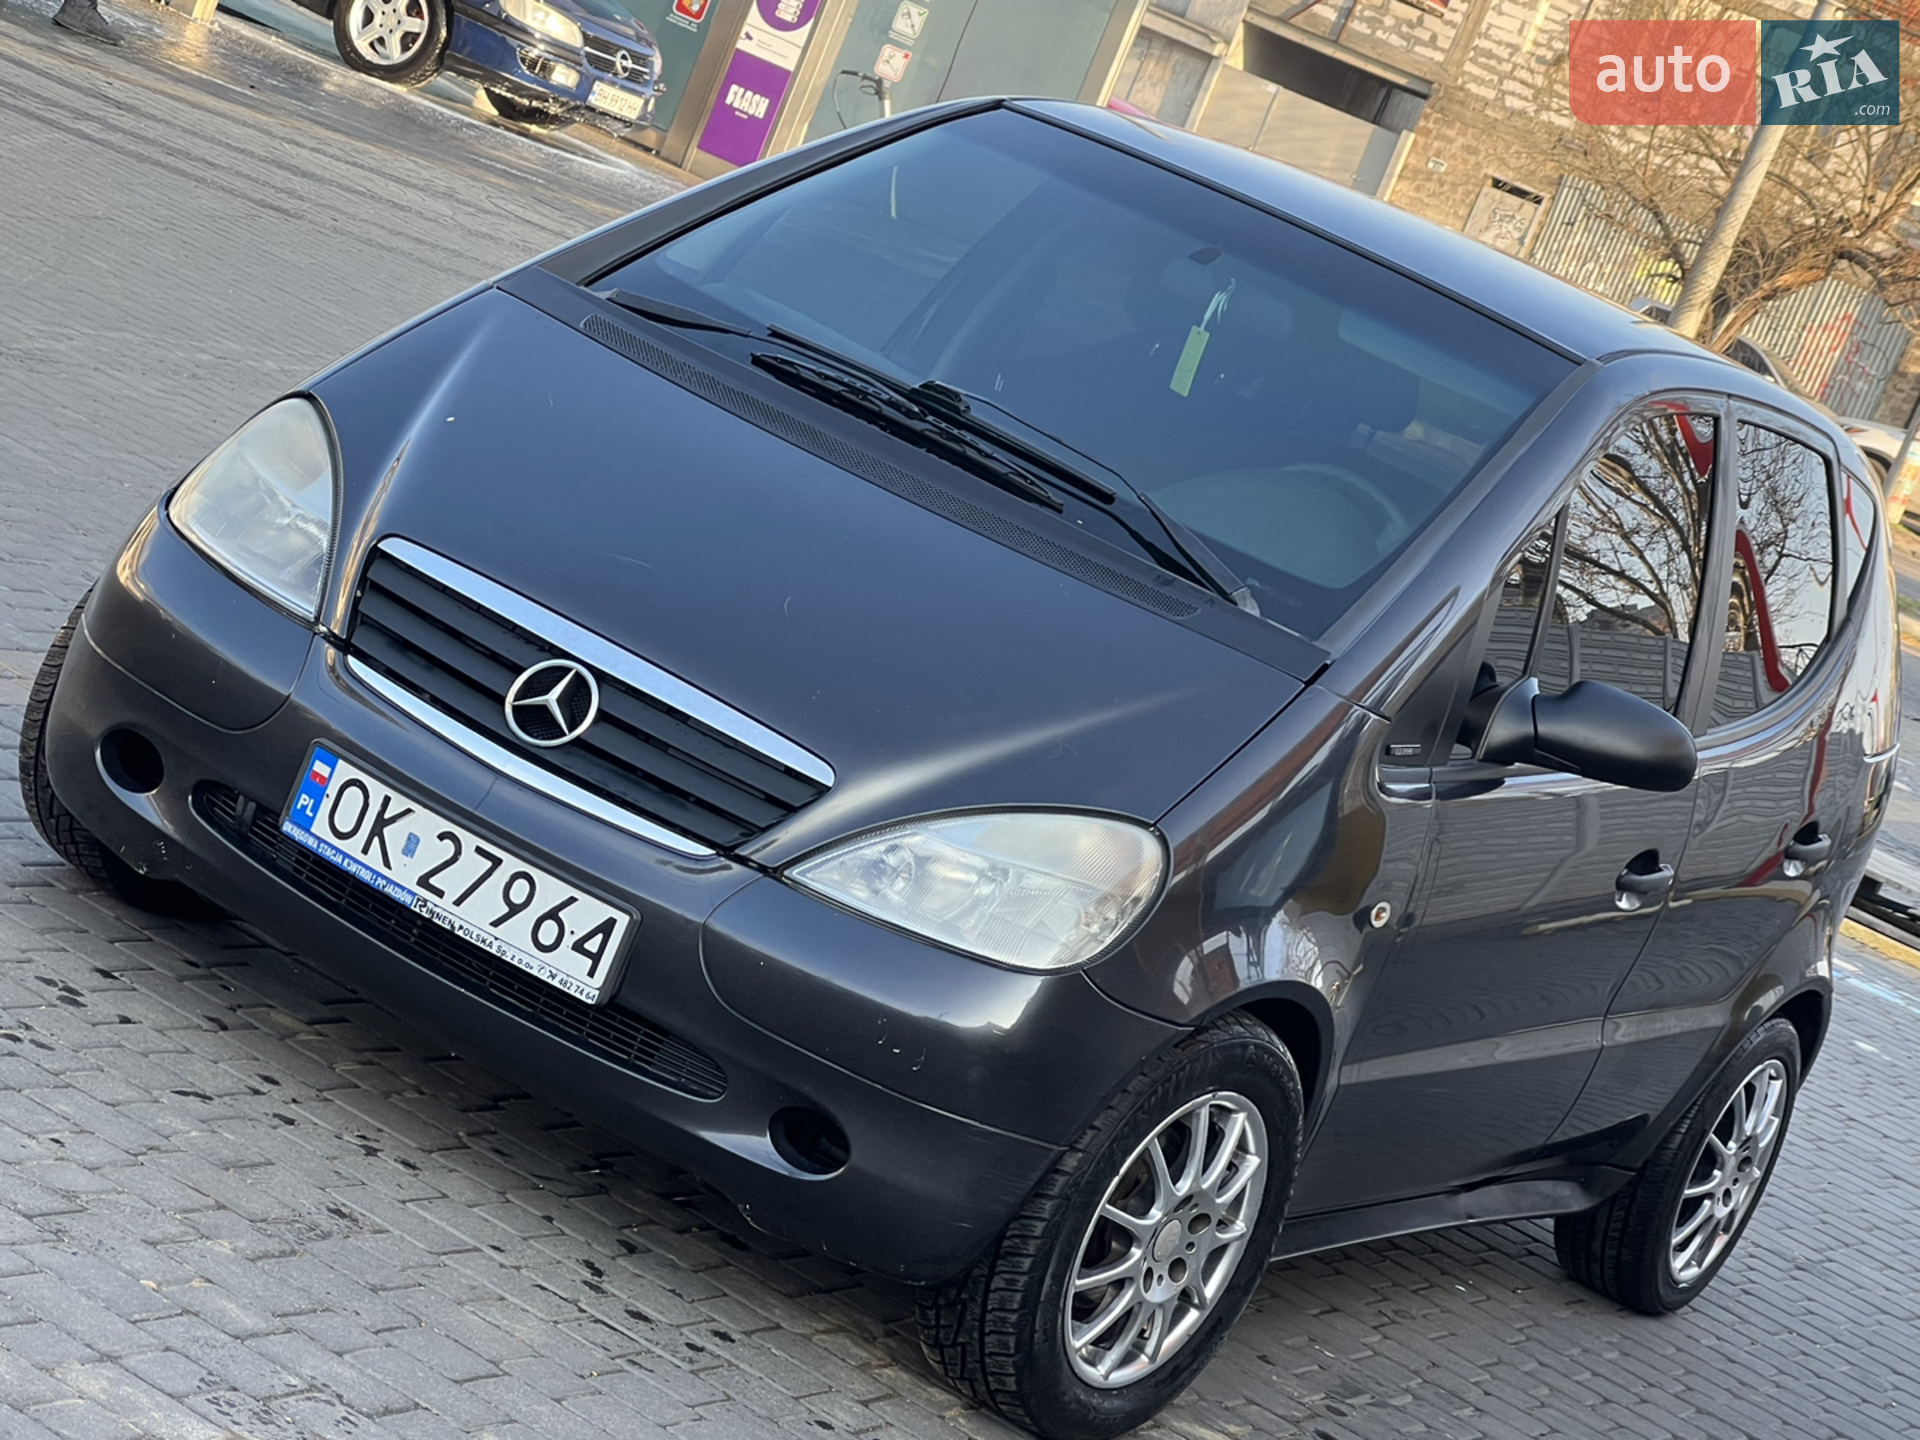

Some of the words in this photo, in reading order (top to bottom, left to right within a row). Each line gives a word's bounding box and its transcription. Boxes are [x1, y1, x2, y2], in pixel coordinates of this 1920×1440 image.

[725, 84, 770, 119] FLASH
[296, 793, 314, 817] PL
[319, 842, 343, 865] STACJA
[328, 778, 416, 871] OK
[416, 831, 618, 979] 27964
[456, 923, 494, 950] POLSKA
[495, 945, 508, 958] Sp.
[558, 977, 573, 991] 482
[574, 985, 584, 996] 74
[585, 991, 596, 1002] 64
